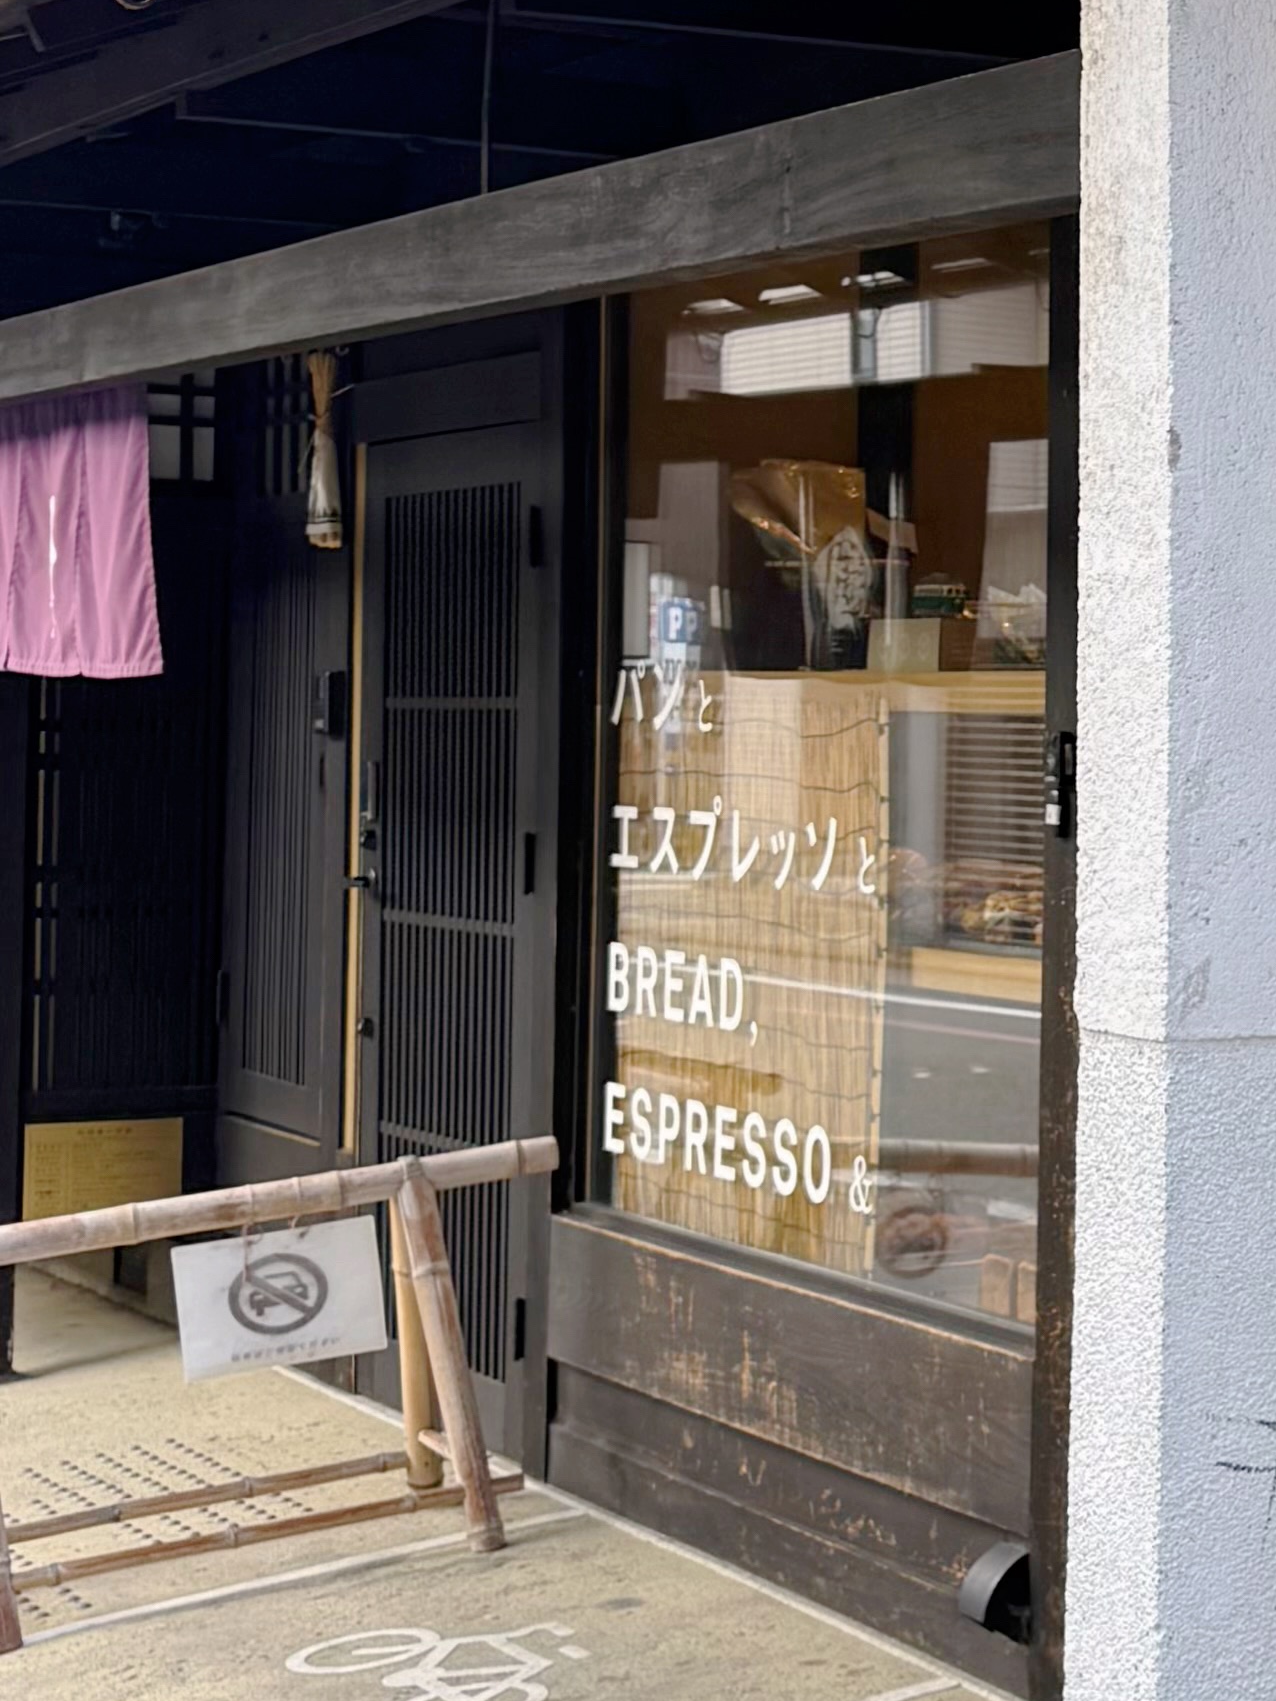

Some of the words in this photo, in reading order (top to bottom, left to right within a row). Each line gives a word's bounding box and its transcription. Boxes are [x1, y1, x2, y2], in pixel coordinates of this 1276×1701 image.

[610, 665, 713, 732] パンと
[610, 795, 877, 894] エスプレッソと
[607, 941, 758, 1046] BREAD,
[603, 1081, 832, 1204] ESPRESSO
[848, 1154, 875, 1214] &
